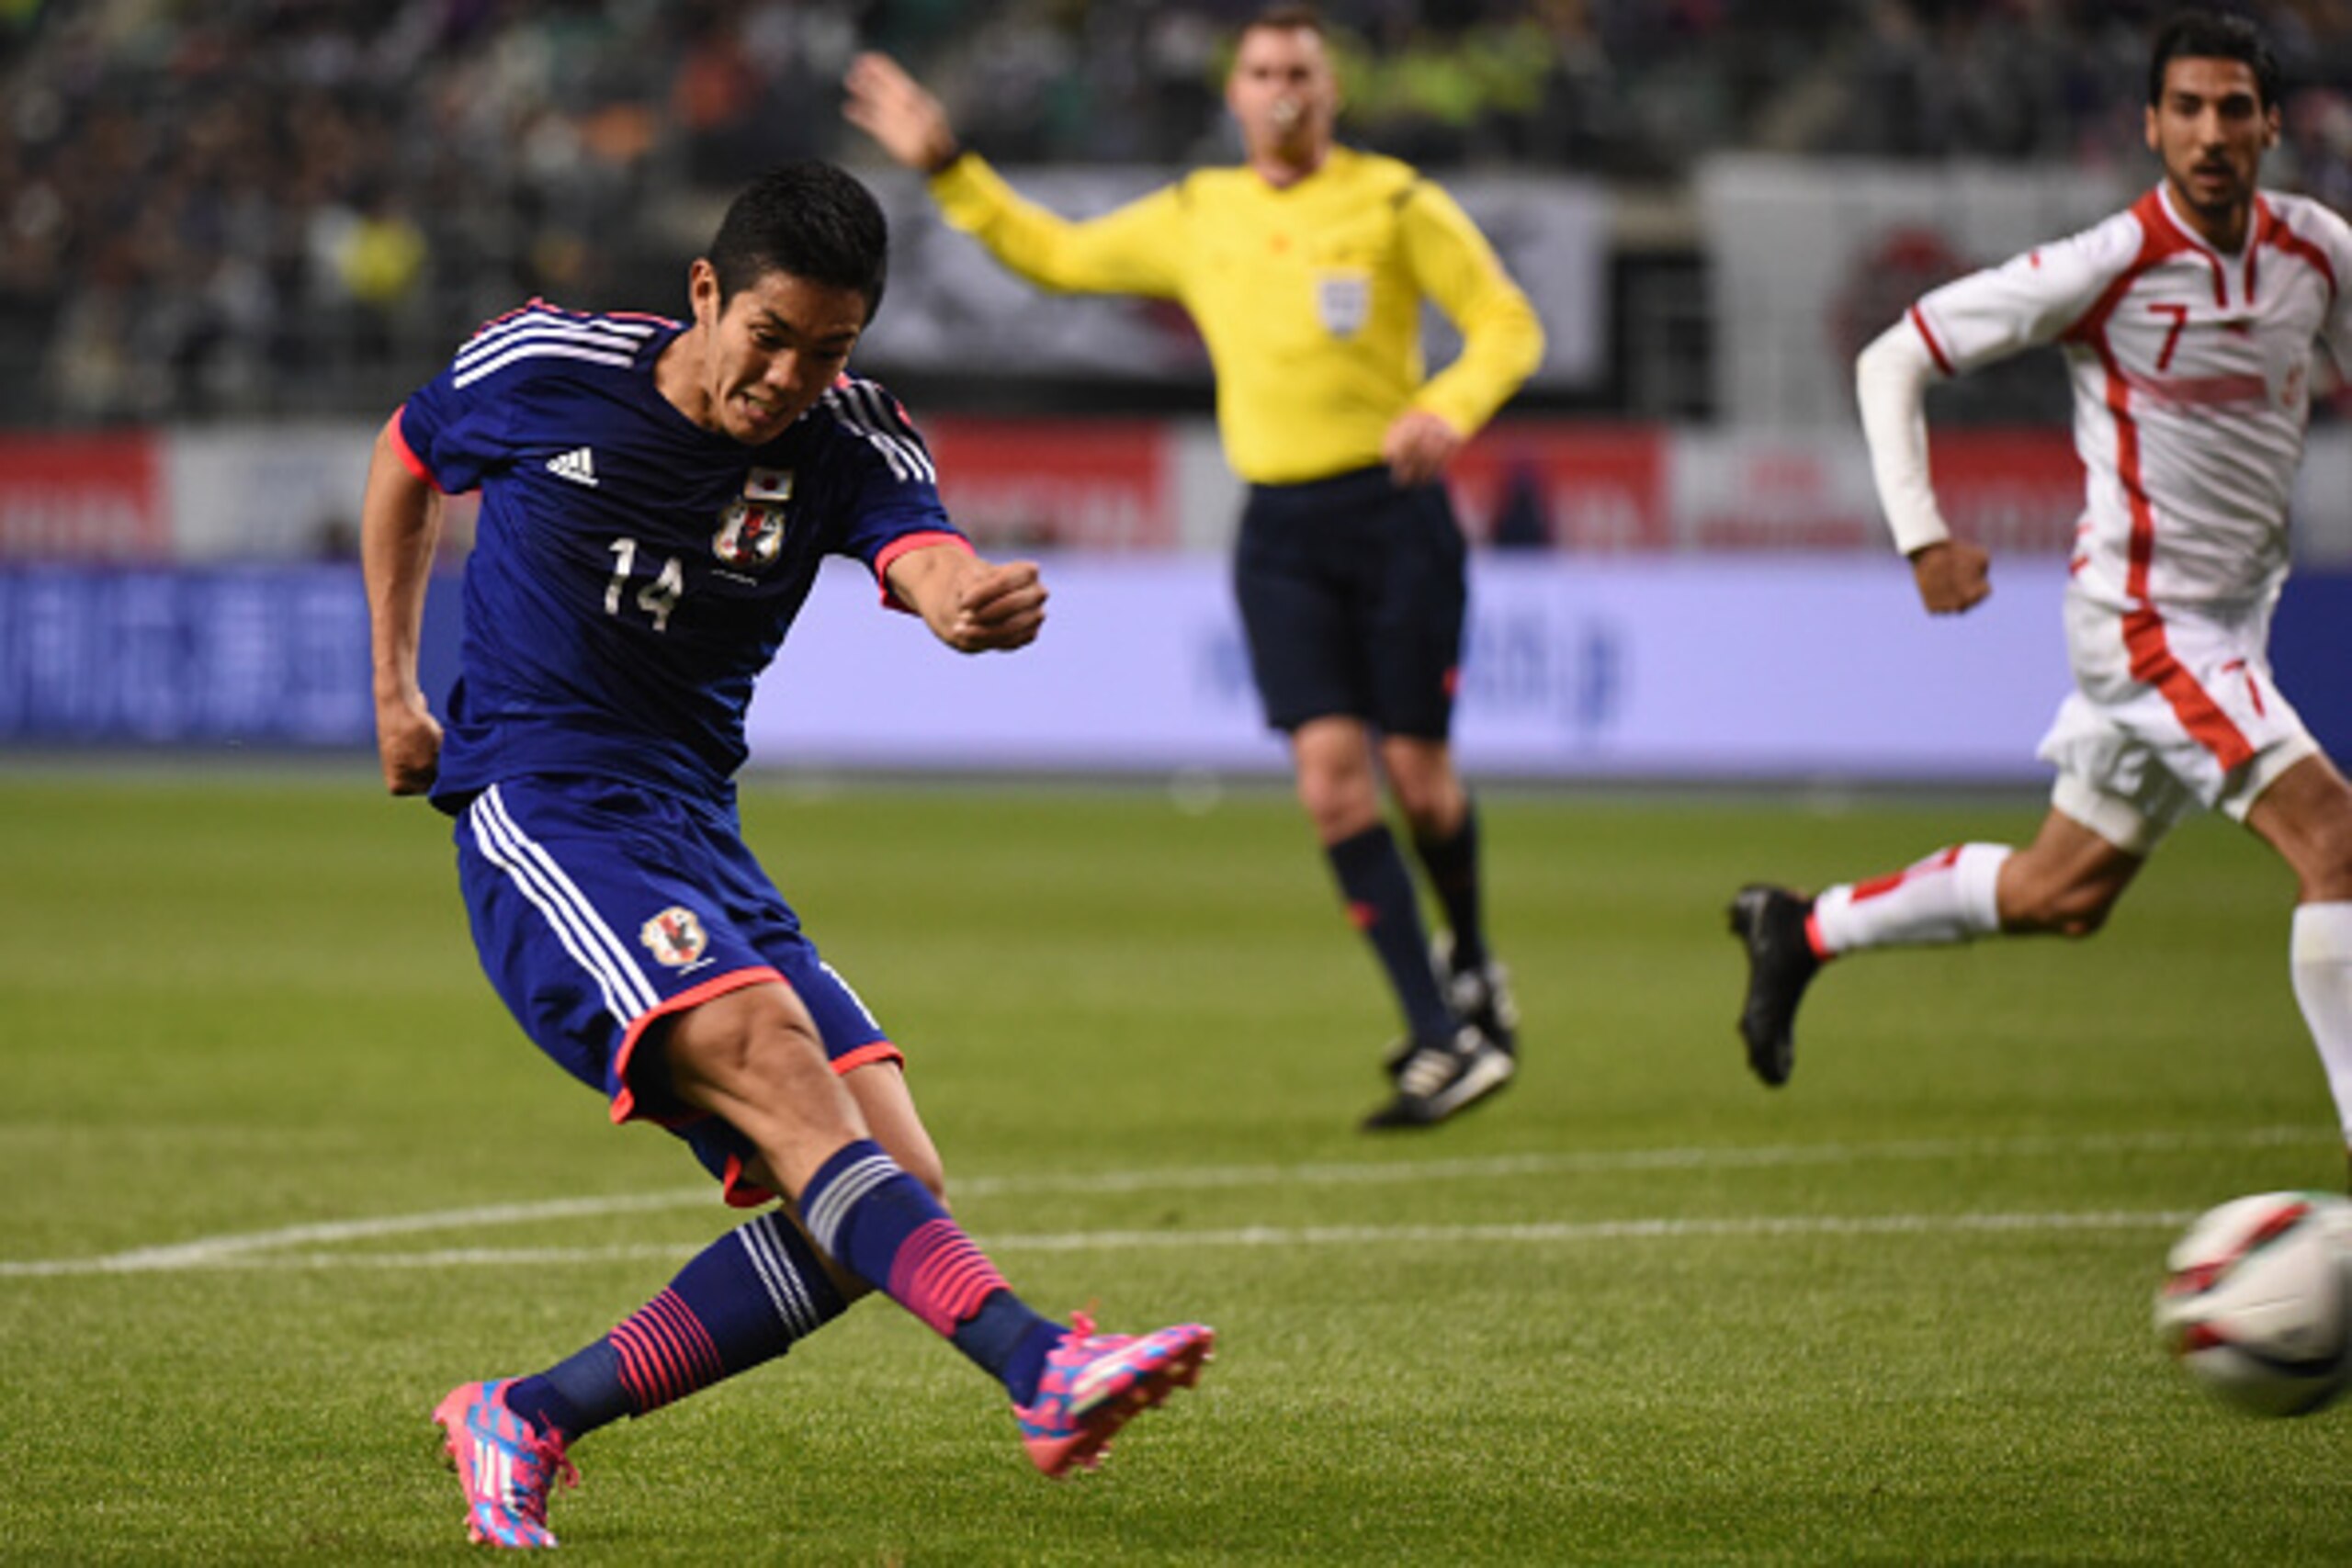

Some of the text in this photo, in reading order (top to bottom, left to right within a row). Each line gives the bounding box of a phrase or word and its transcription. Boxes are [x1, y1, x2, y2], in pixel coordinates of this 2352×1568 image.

[2146, 303, 2188, 373] 7
[605, 537, 683, 632] 14
[2221, 657, 2266, 720] 7
